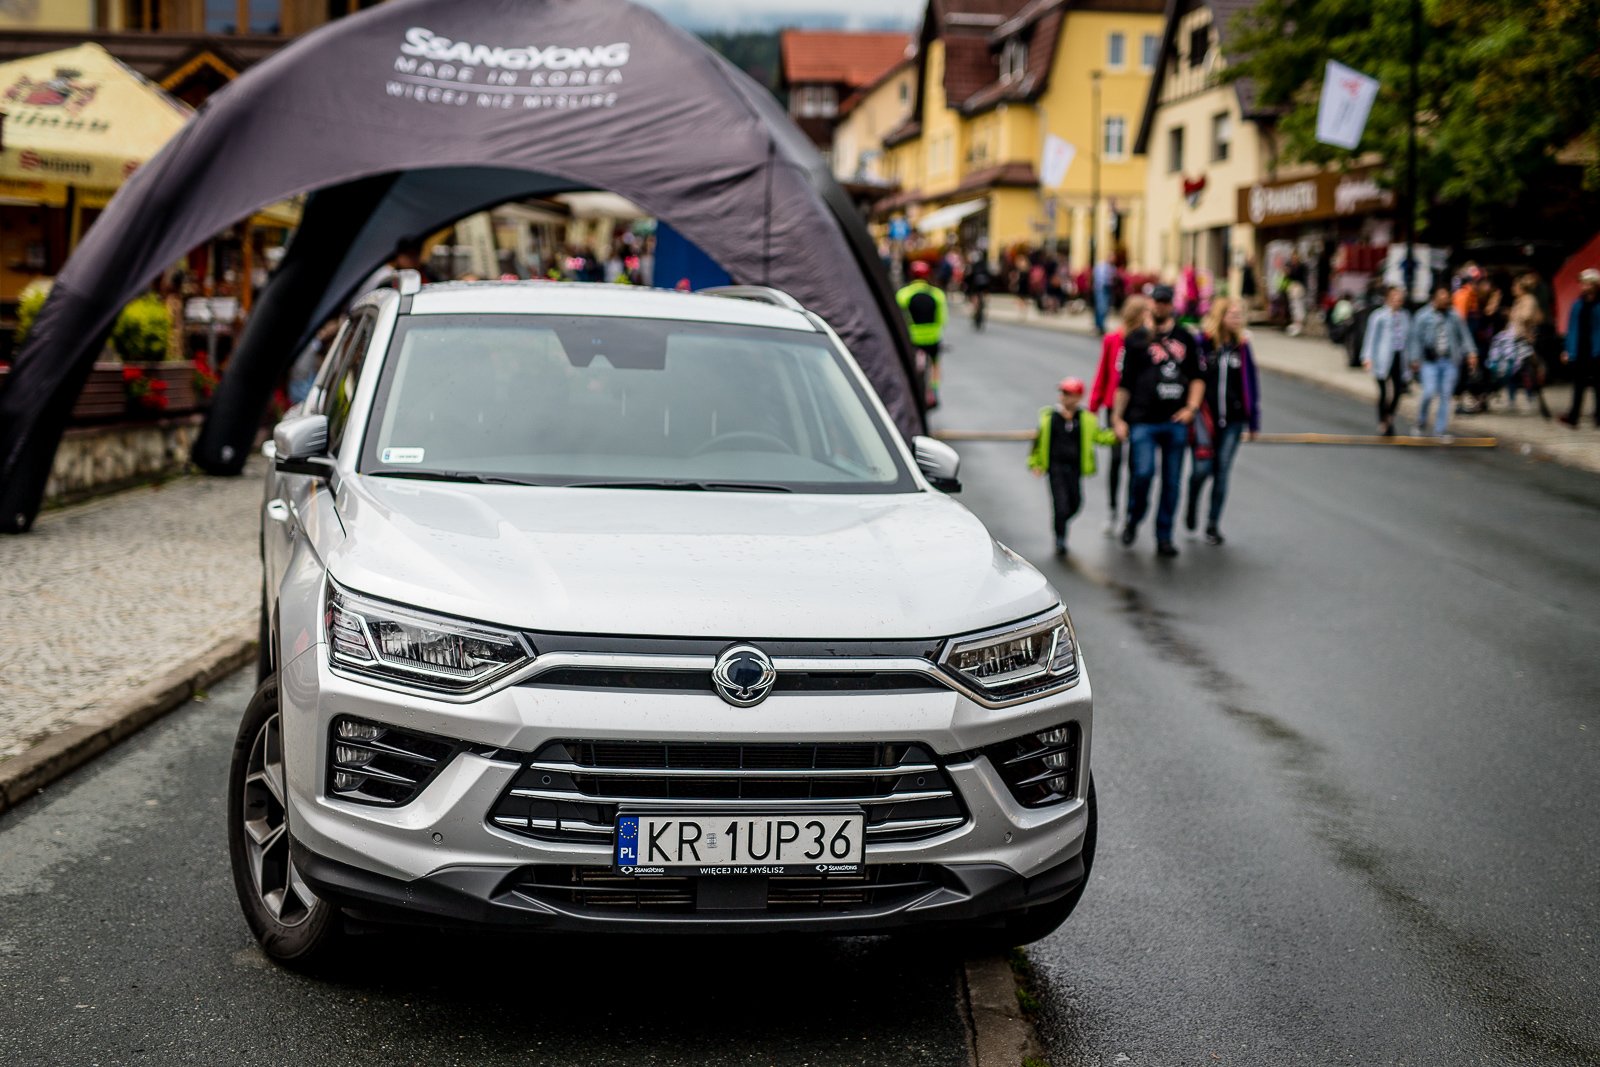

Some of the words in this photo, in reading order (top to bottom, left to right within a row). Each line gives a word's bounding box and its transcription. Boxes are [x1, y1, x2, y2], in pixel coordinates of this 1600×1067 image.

[394, 55, 475, 83] MADE
[486, 69, 518, 86] IN
[529, 68, 623, 87] KOREA
[648, 821, 702, 862] KR
[725, 819, 852, 861] 1UP36
[620, 847, 636, 859] PL
[700, 867, 731, 876] WIĘCEJ
[733, 866, 748, 874] NIŻ
[750, 866, 784, 874] MYŚLISZ
